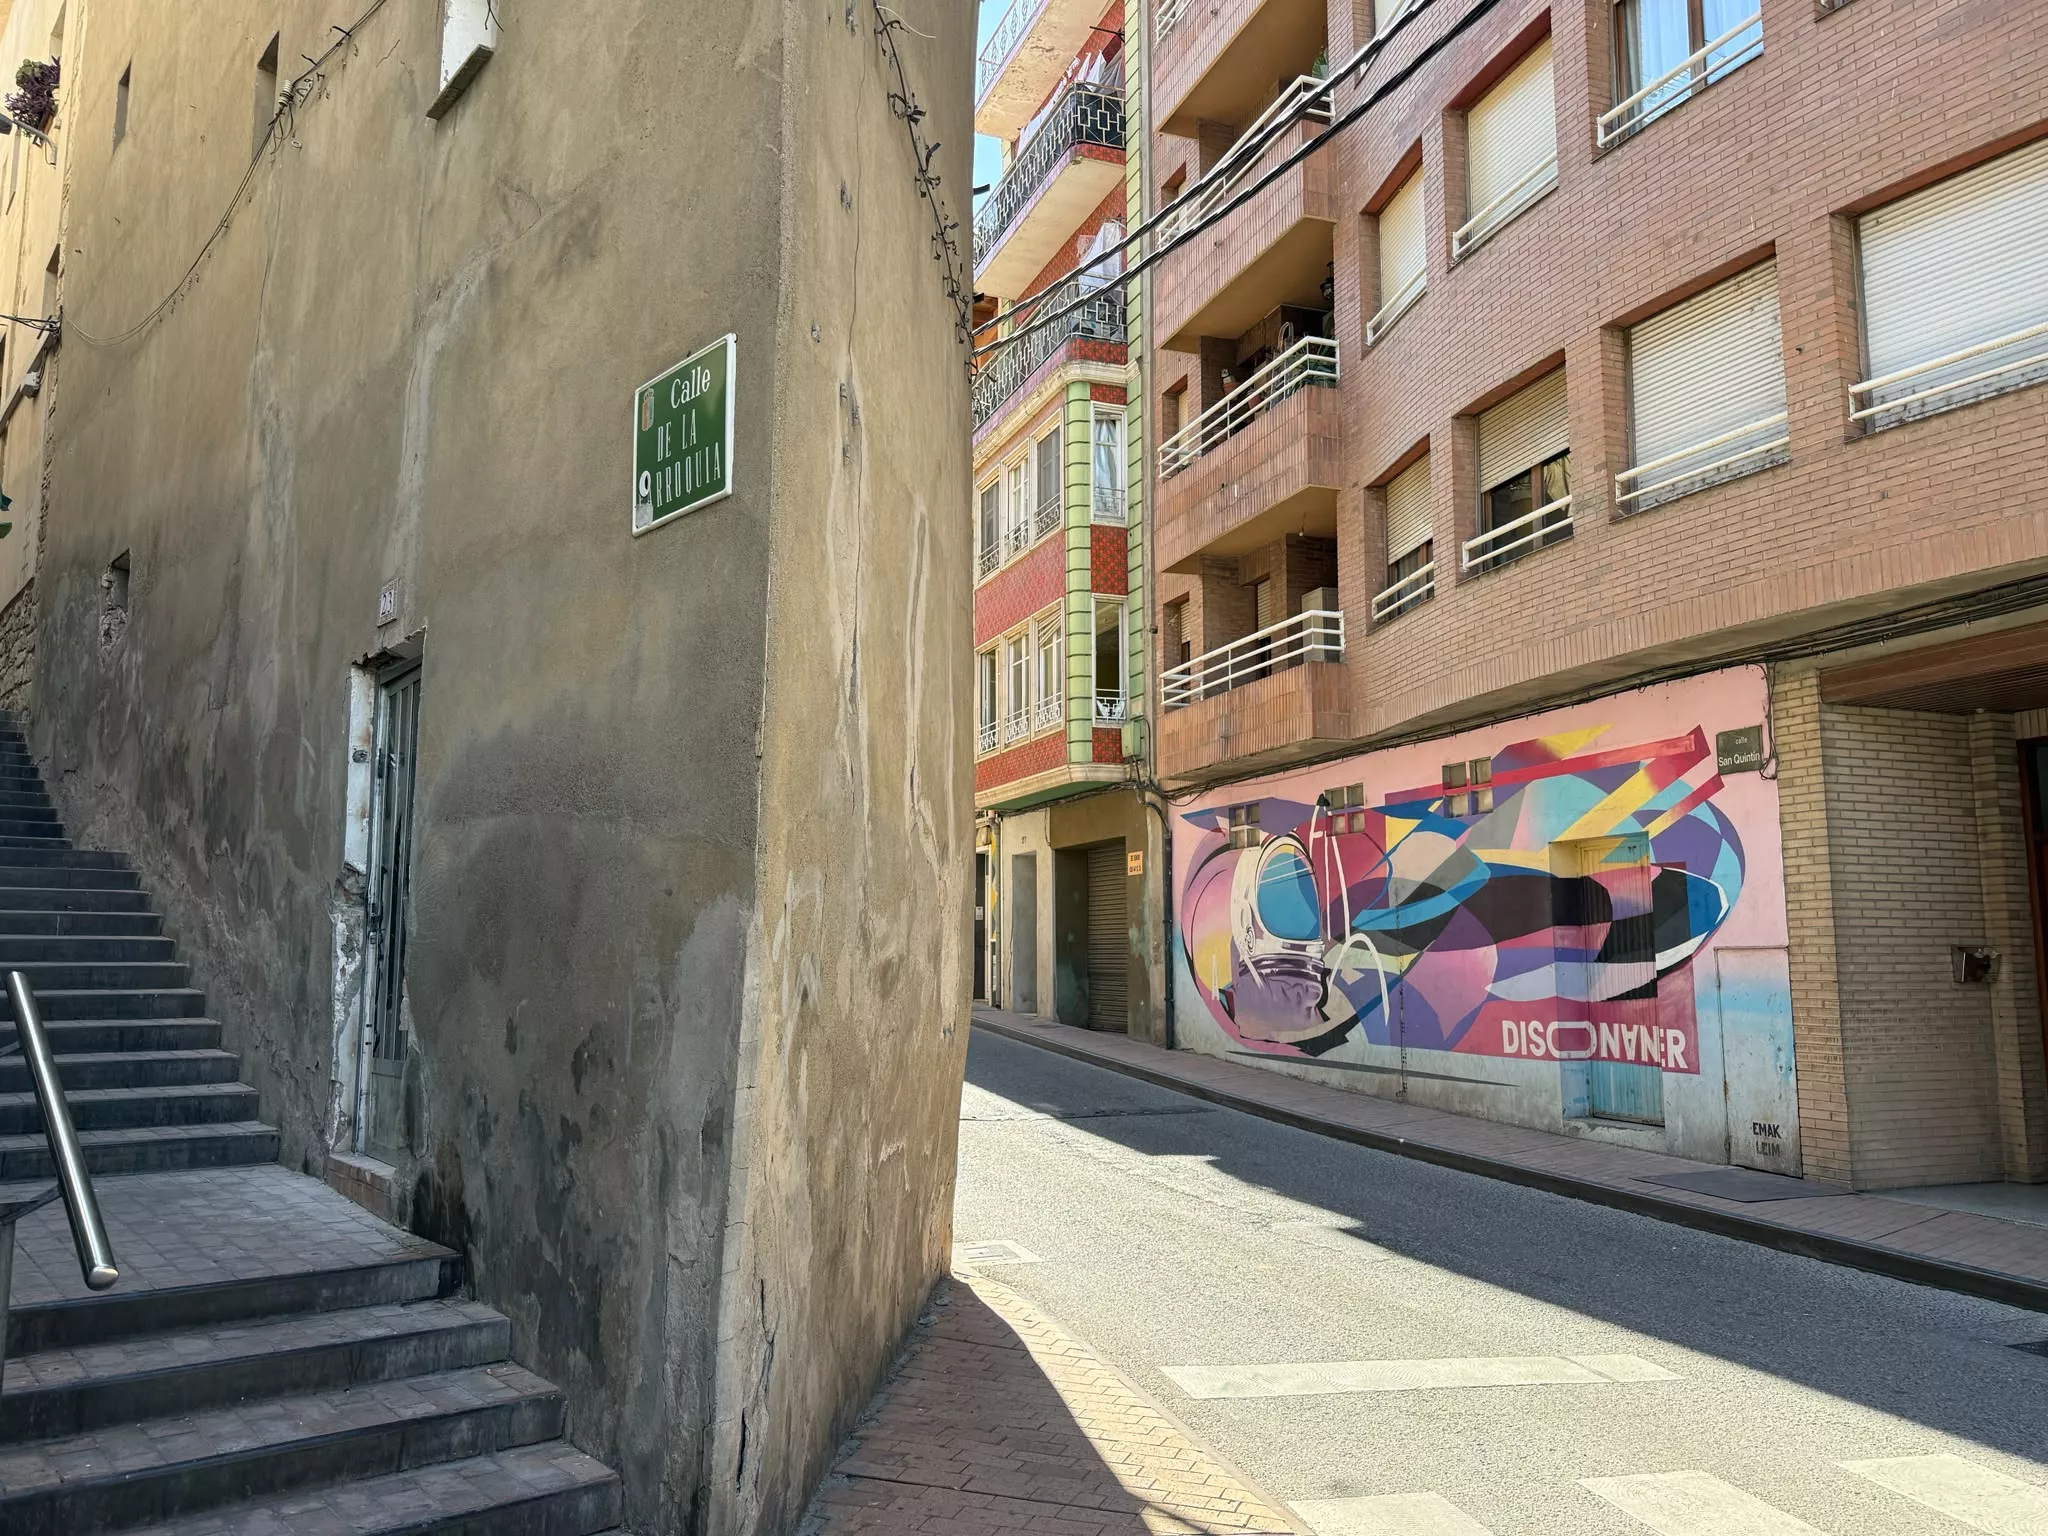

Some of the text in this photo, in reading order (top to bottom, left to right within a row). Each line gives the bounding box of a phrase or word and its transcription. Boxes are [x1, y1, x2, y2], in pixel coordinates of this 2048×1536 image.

[670, 366, 711, 409] Calle
[657, 408, 697, 462] DE LA
[381, 591, 393, 616] 23
[1735, 736, 1748, 745] calle
[1718, 750, 1760, 767] San Quintín
[1752, 1121, 1782, 1139] EMAK
